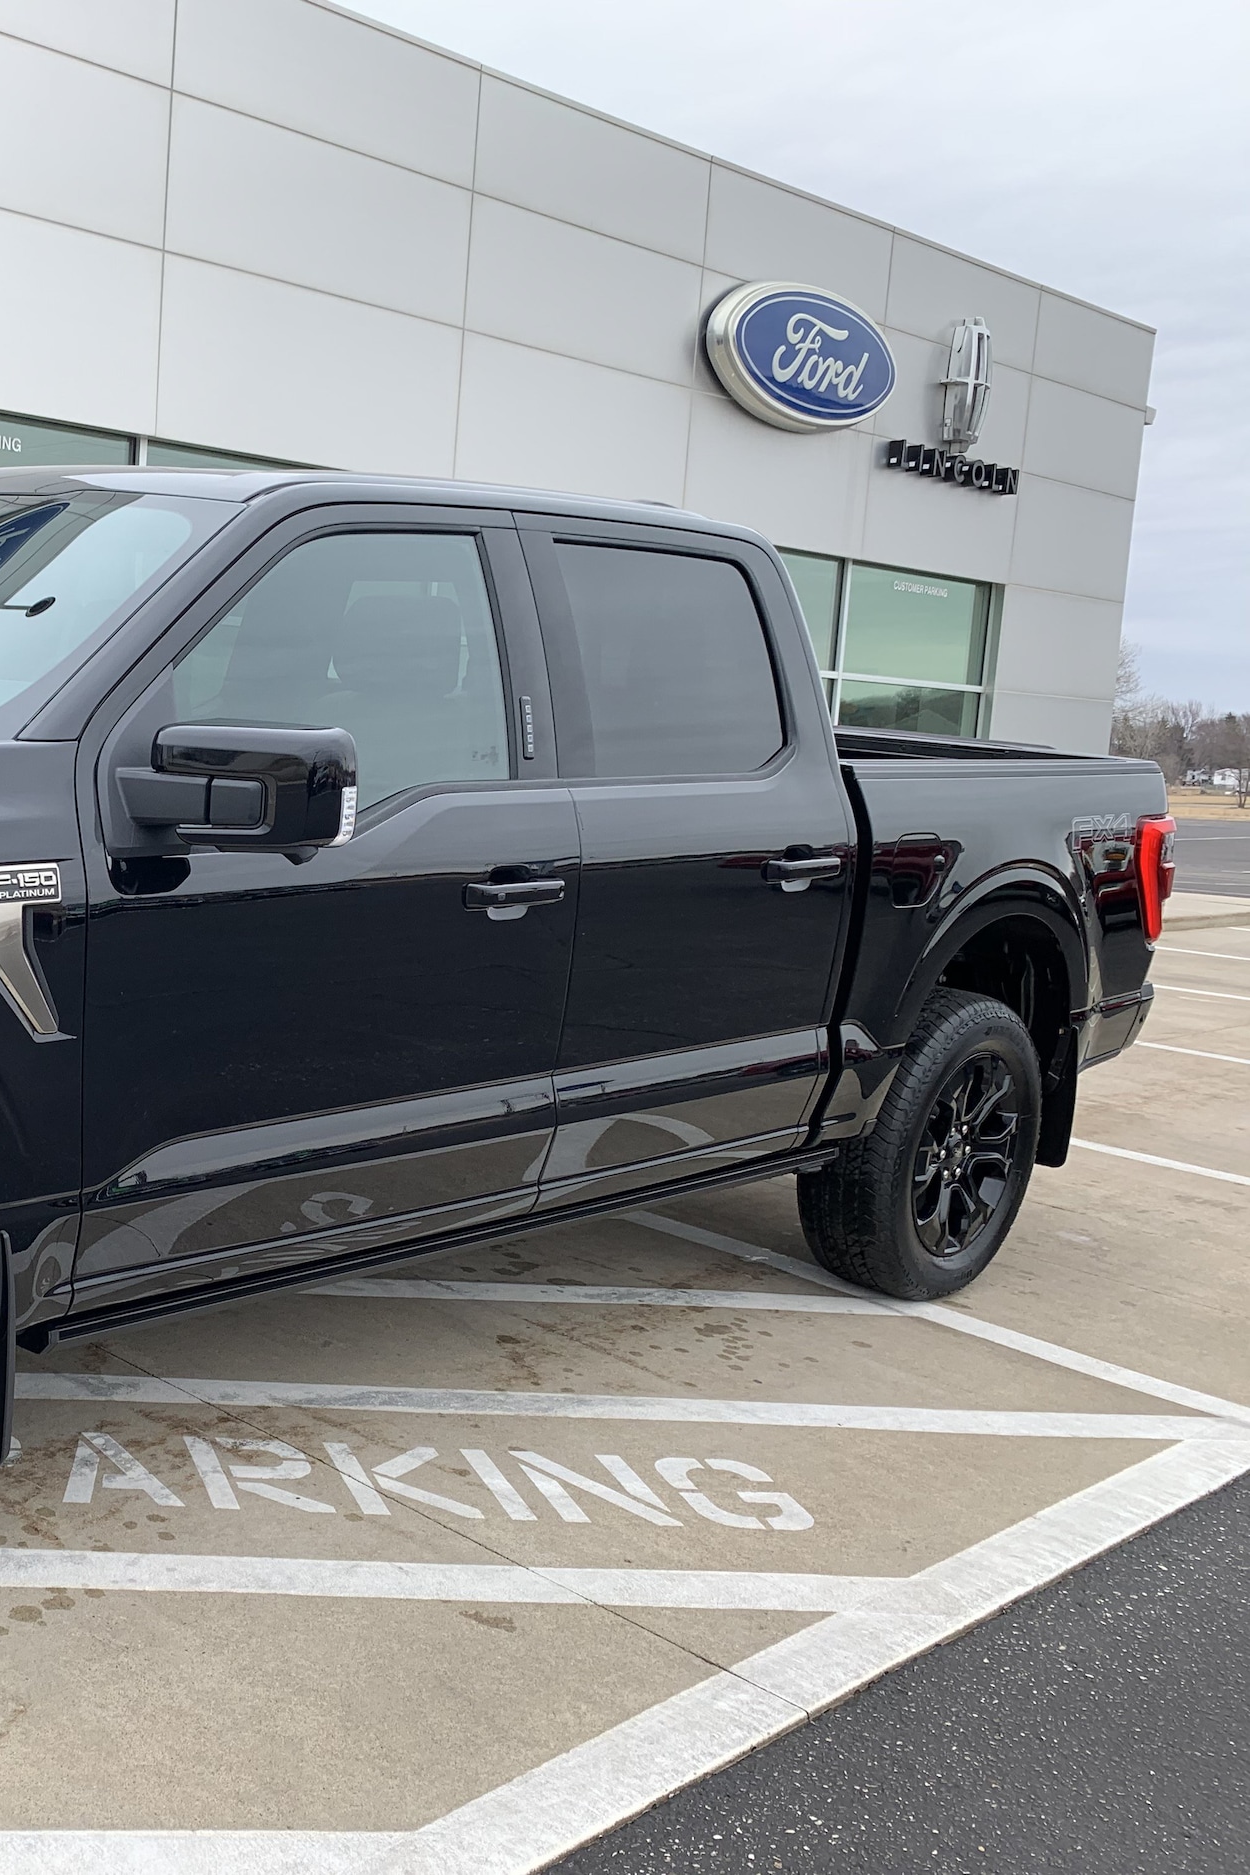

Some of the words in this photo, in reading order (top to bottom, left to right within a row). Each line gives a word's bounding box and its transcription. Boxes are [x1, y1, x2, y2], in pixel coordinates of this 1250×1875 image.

[771, 312, 870, 401] Ford
[888, 439, 1020, 495] LINCOLN
[893, 580, 924, 594] CUSTOMER
[924, 585, 948, 598] PARKING
[1071, 813, 1133, 853] FX4
